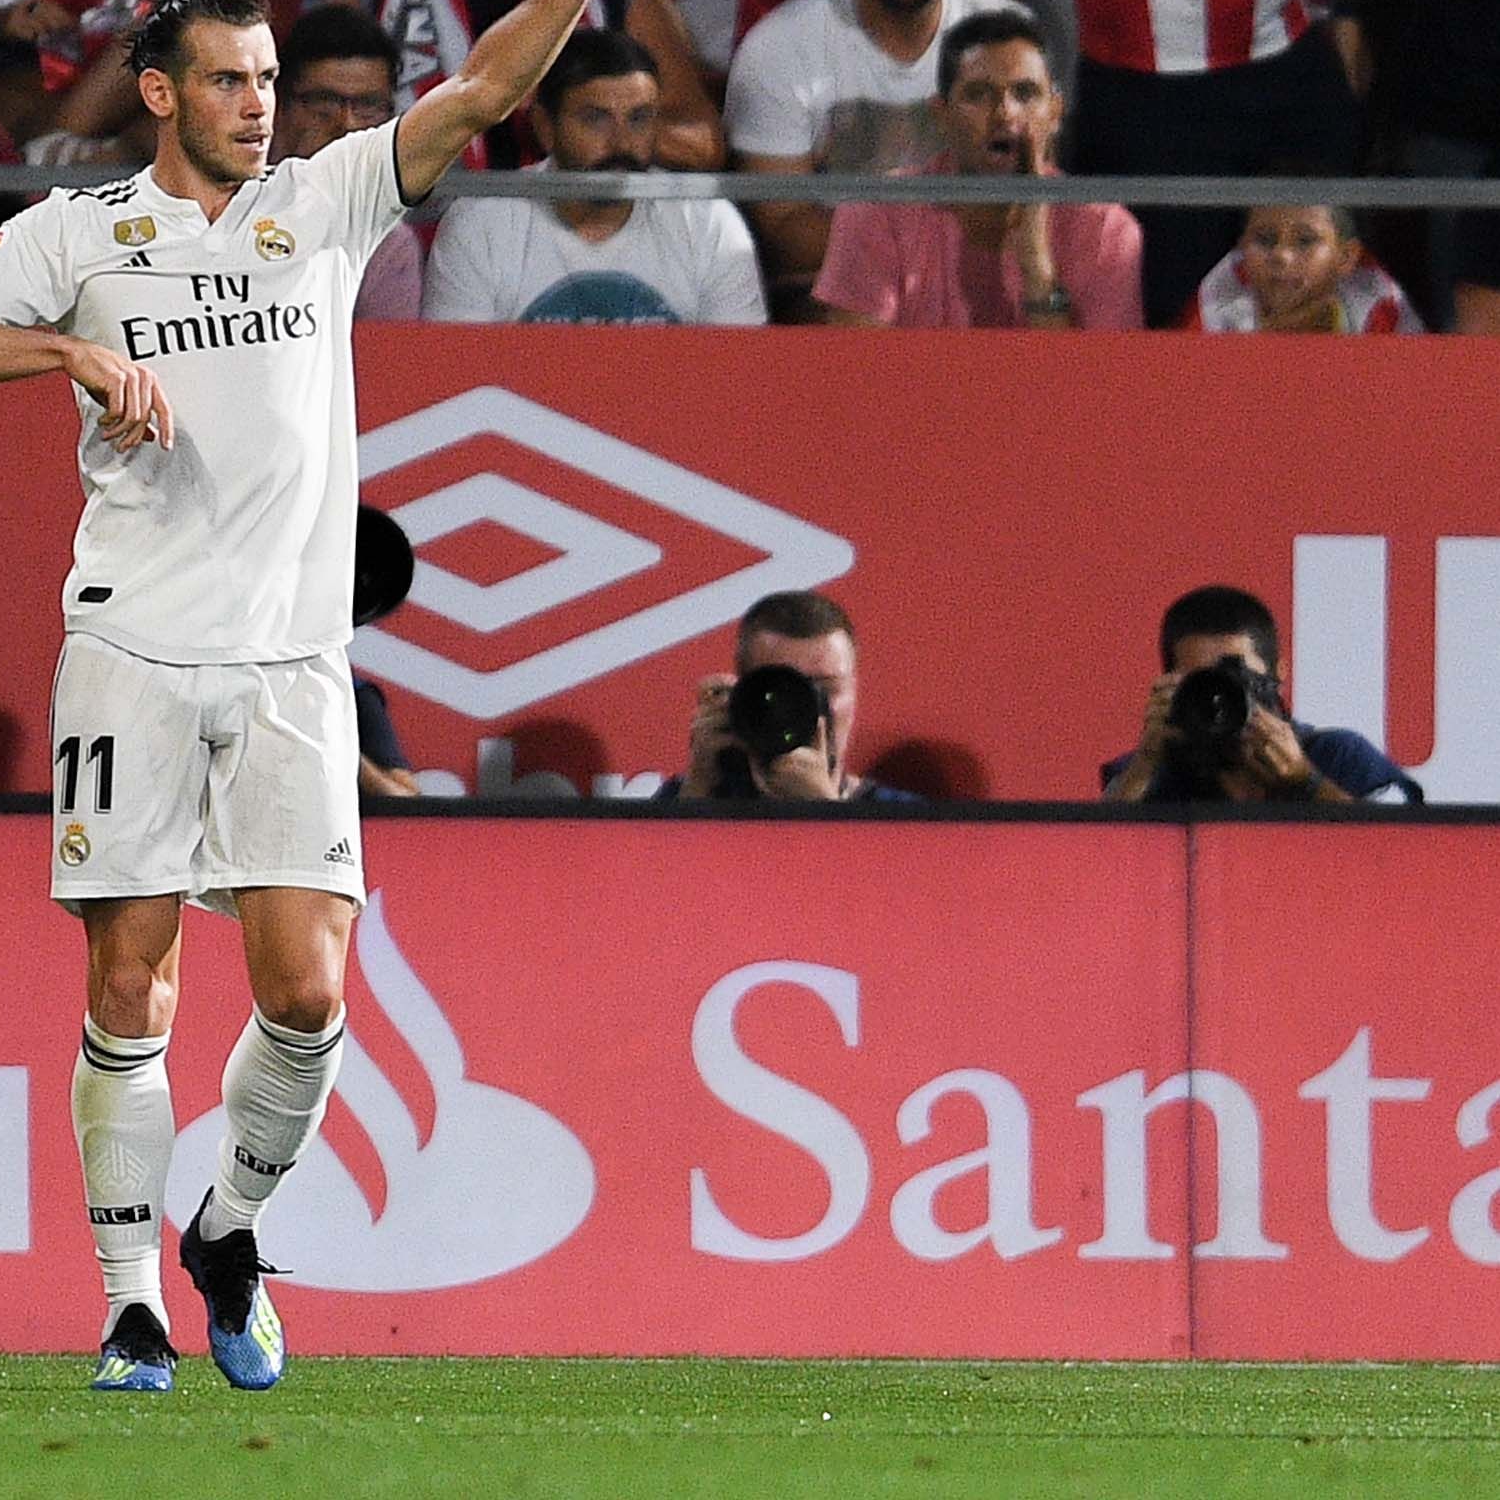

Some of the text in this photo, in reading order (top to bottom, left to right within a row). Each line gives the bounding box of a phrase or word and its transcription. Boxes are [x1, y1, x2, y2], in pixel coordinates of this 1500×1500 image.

[191, 274, 250, 303] Fly
[121, 303, 318, 362] Emirates
[55, 735, 115, 814] 11
